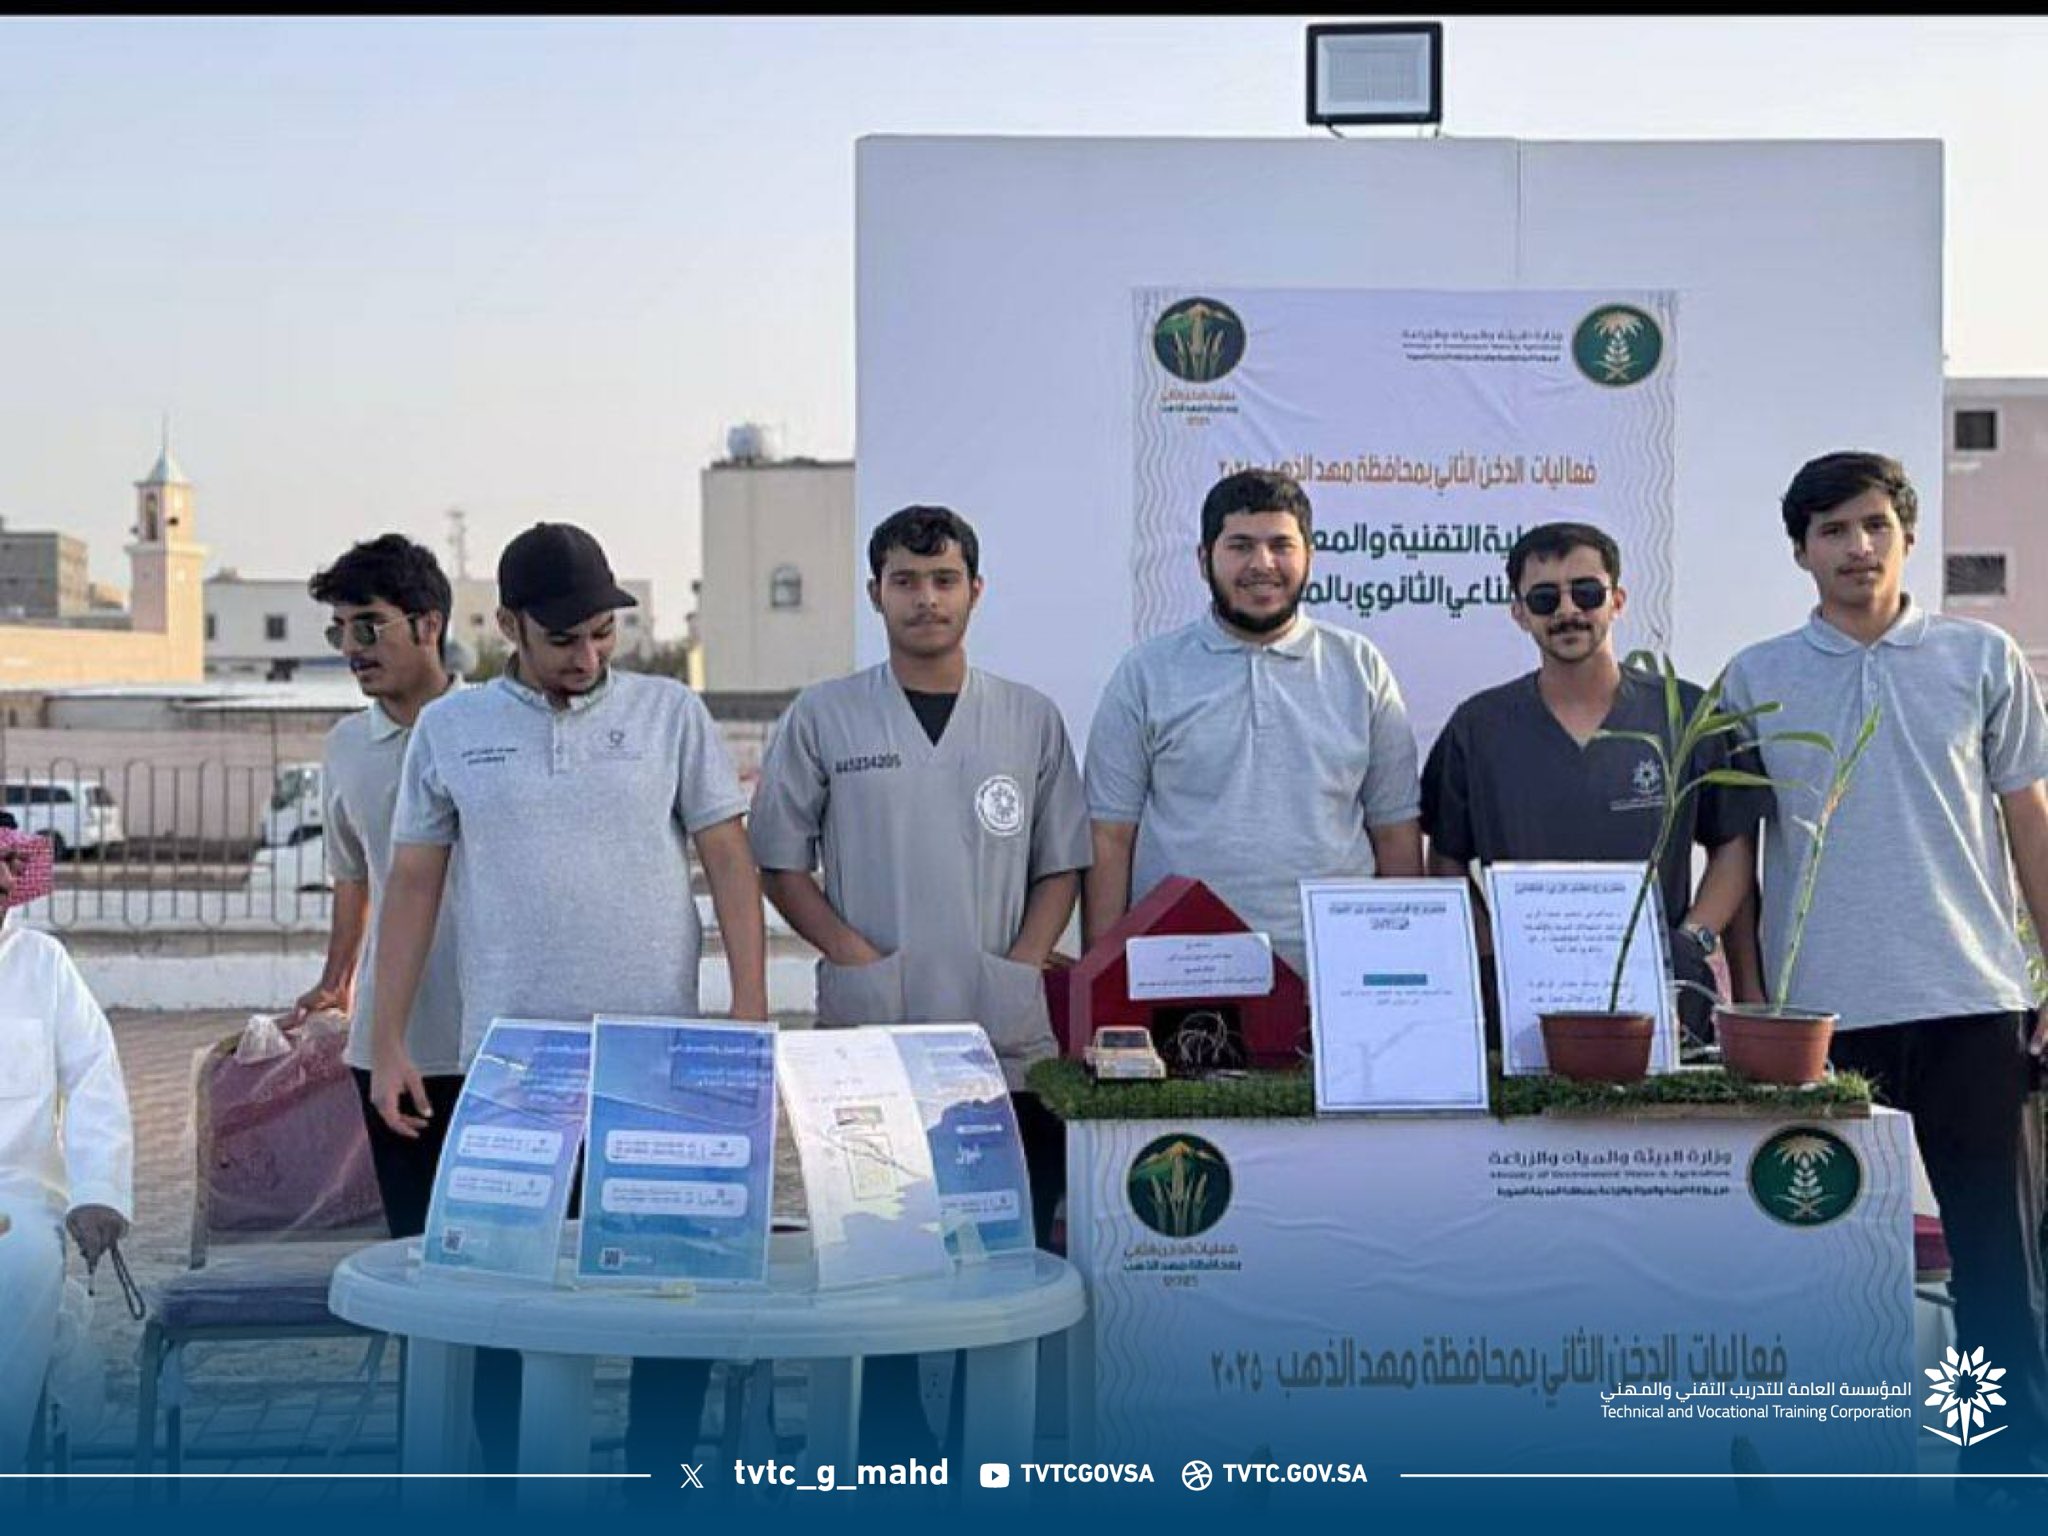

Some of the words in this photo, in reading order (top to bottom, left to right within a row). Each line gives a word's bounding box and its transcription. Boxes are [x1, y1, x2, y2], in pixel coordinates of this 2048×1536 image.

[1357, 454, 1433, 489] بمحافظة
[1531, 454, 1597, 490] فعاليات
[1311, 522, 1388, 560] والمع
[1389, 523, 1482, 560] التقنية
[1301, 574, 1353, 611] بالم
[1356, 570, 1444, 618] الثانوي
[1277, 1336, 1355, 1399] الذهب
[1359, 1350, 1416, 1390] مهد
[1421, 1335, 1538, 1396] بمحافظة
[1542, 1327, 1603, 1408] الثاني
[1609, 1334, 1678, 1393] الدخن
[1688, 1334, 1788, 1391] فعاليات
